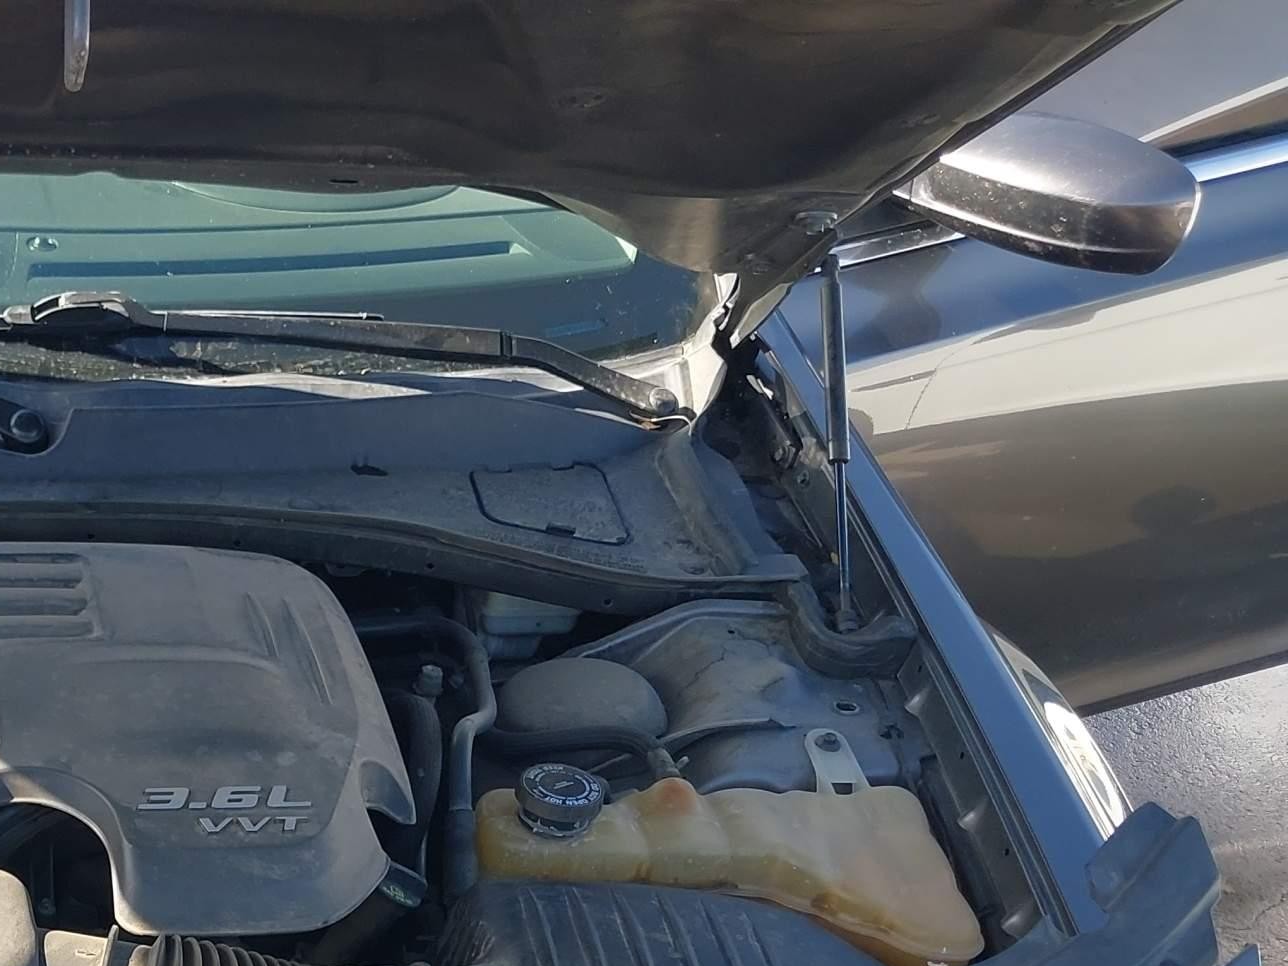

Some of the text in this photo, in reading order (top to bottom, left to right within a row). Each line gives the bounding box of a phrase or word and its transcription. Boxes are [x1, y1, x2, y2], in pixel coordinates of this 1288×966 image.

[137, 785, 312, 810] 3.6L
[565, 798, 589, 806] OPEN
[199, 816, 308, 832] VVT
